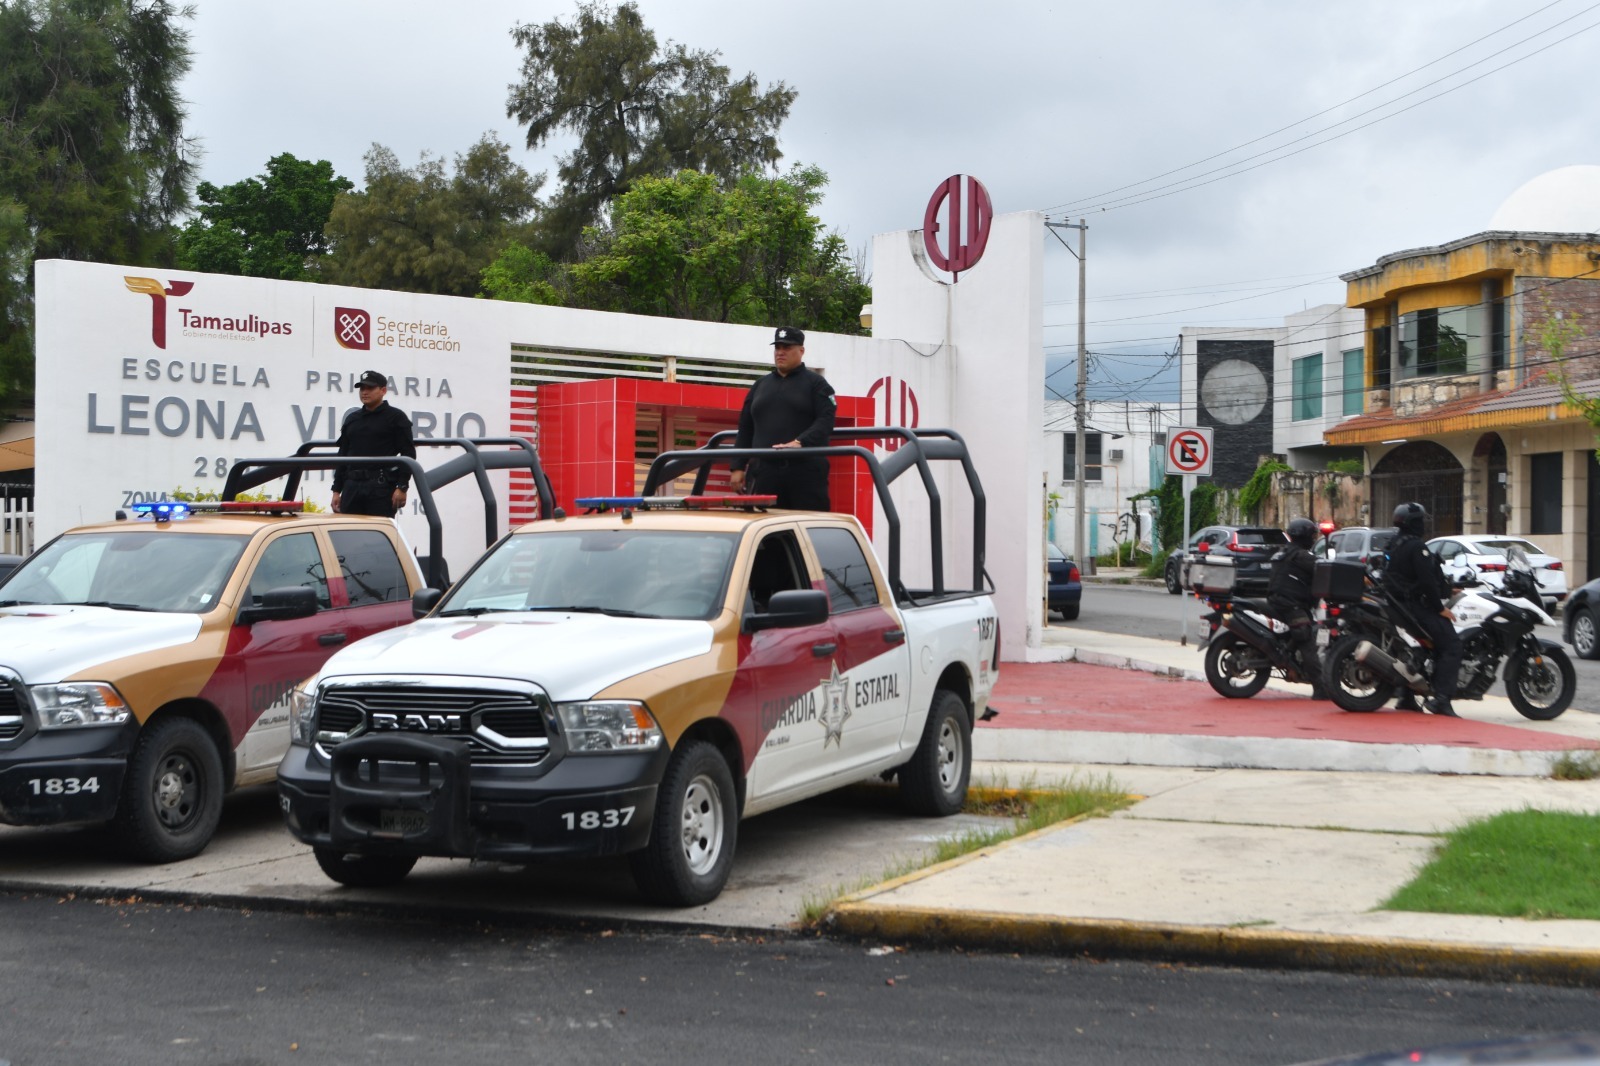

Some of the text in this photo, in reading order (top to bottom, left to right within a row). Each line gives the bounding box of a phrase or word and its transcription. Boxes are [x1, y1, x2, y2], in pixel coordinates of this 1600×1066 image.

[178, 308, 292, 337] Tamaulipas
[377, 316, 448, 336] Secretaría
[182, 329, 256, 342] Gobierno del Estado
[377, 331, 460, 352] de Educación
[122, 358, 453, 398] ESCUELA PRIARIA
[88, 392, 487, 450] LEONA VIRIO
[1180, 439, 1199, 463] E
[252, 679, 303, 713] GUAR
[761, 673, 900, 733] GUARDIA ESTATAL
[372, 713, 461, 731] RAM
[28, 776, 100, 796] 1834
[561, 806, 636, 831] 1837
